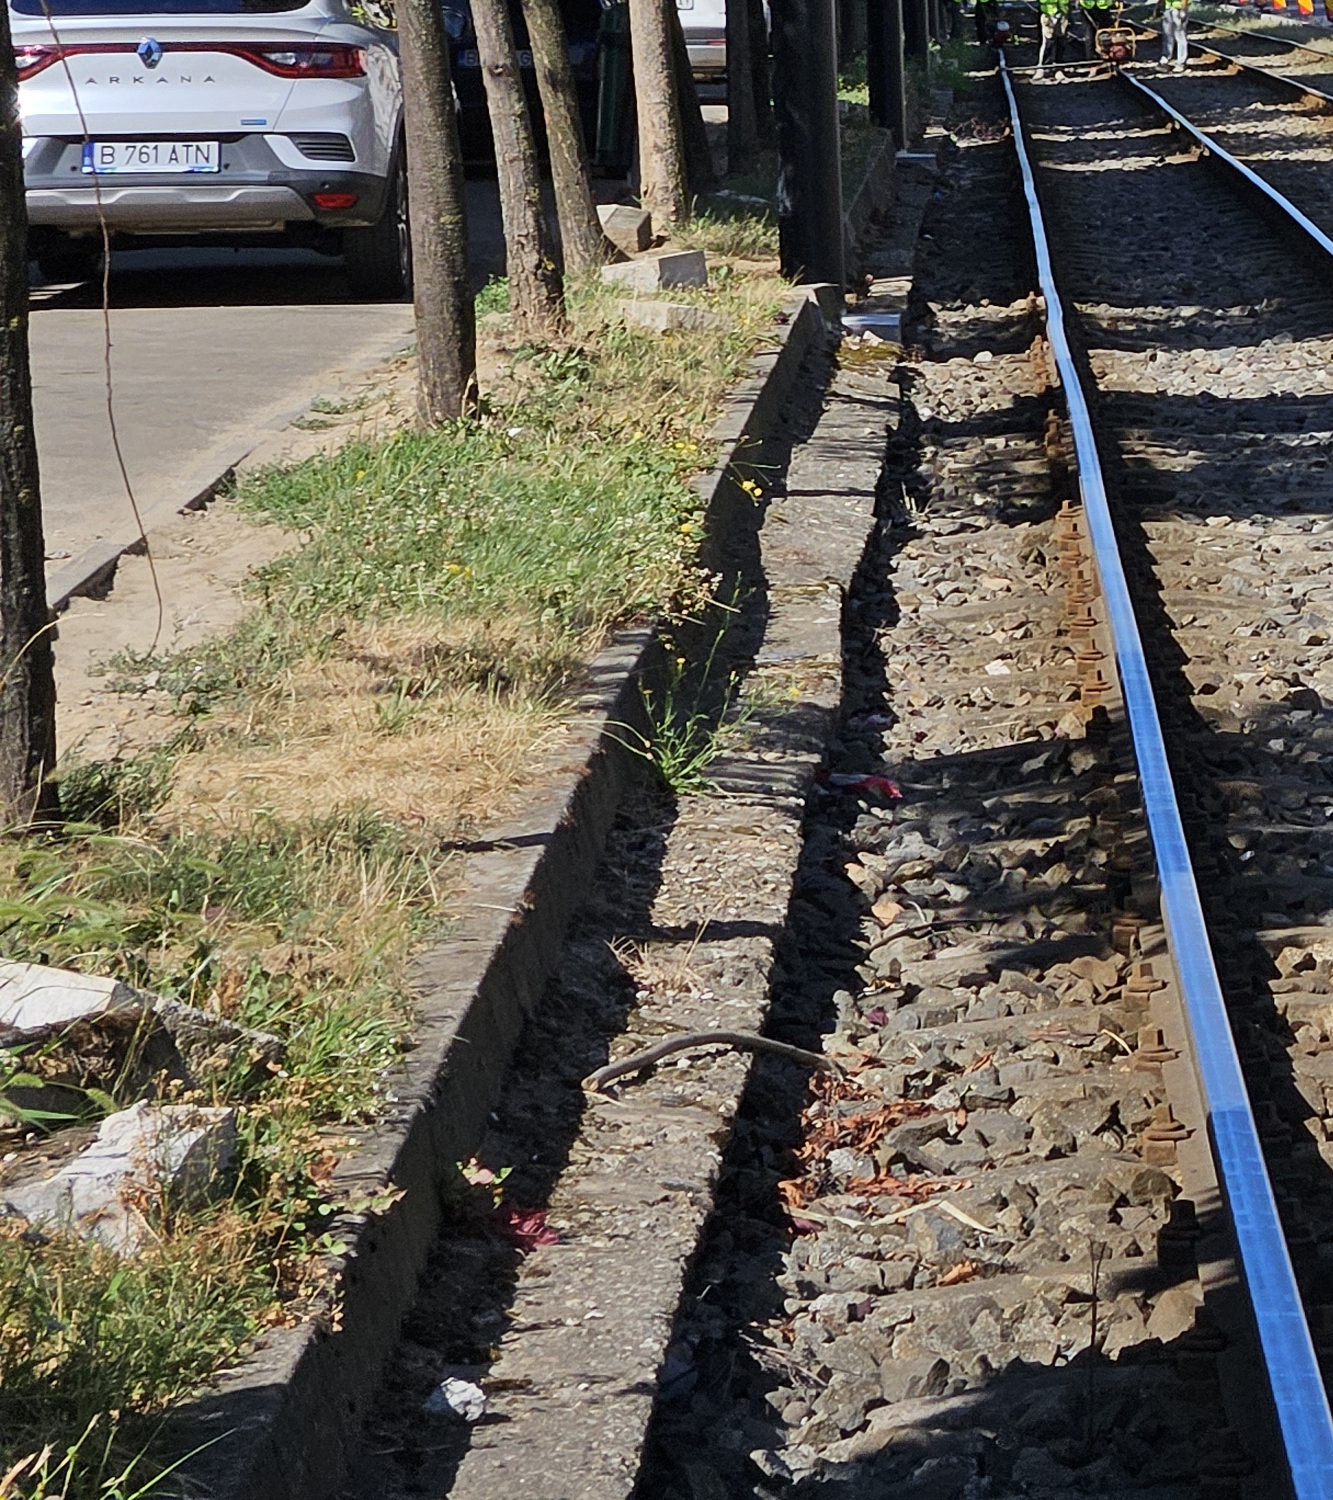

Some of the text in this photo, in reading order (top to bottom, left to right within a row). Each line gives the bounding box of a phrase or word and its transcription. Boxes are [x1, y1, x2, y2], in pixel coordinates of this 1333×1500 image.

[85, 75, 216, 85] ARKANA
[100, 144, 211, 165] B 761 ATN
